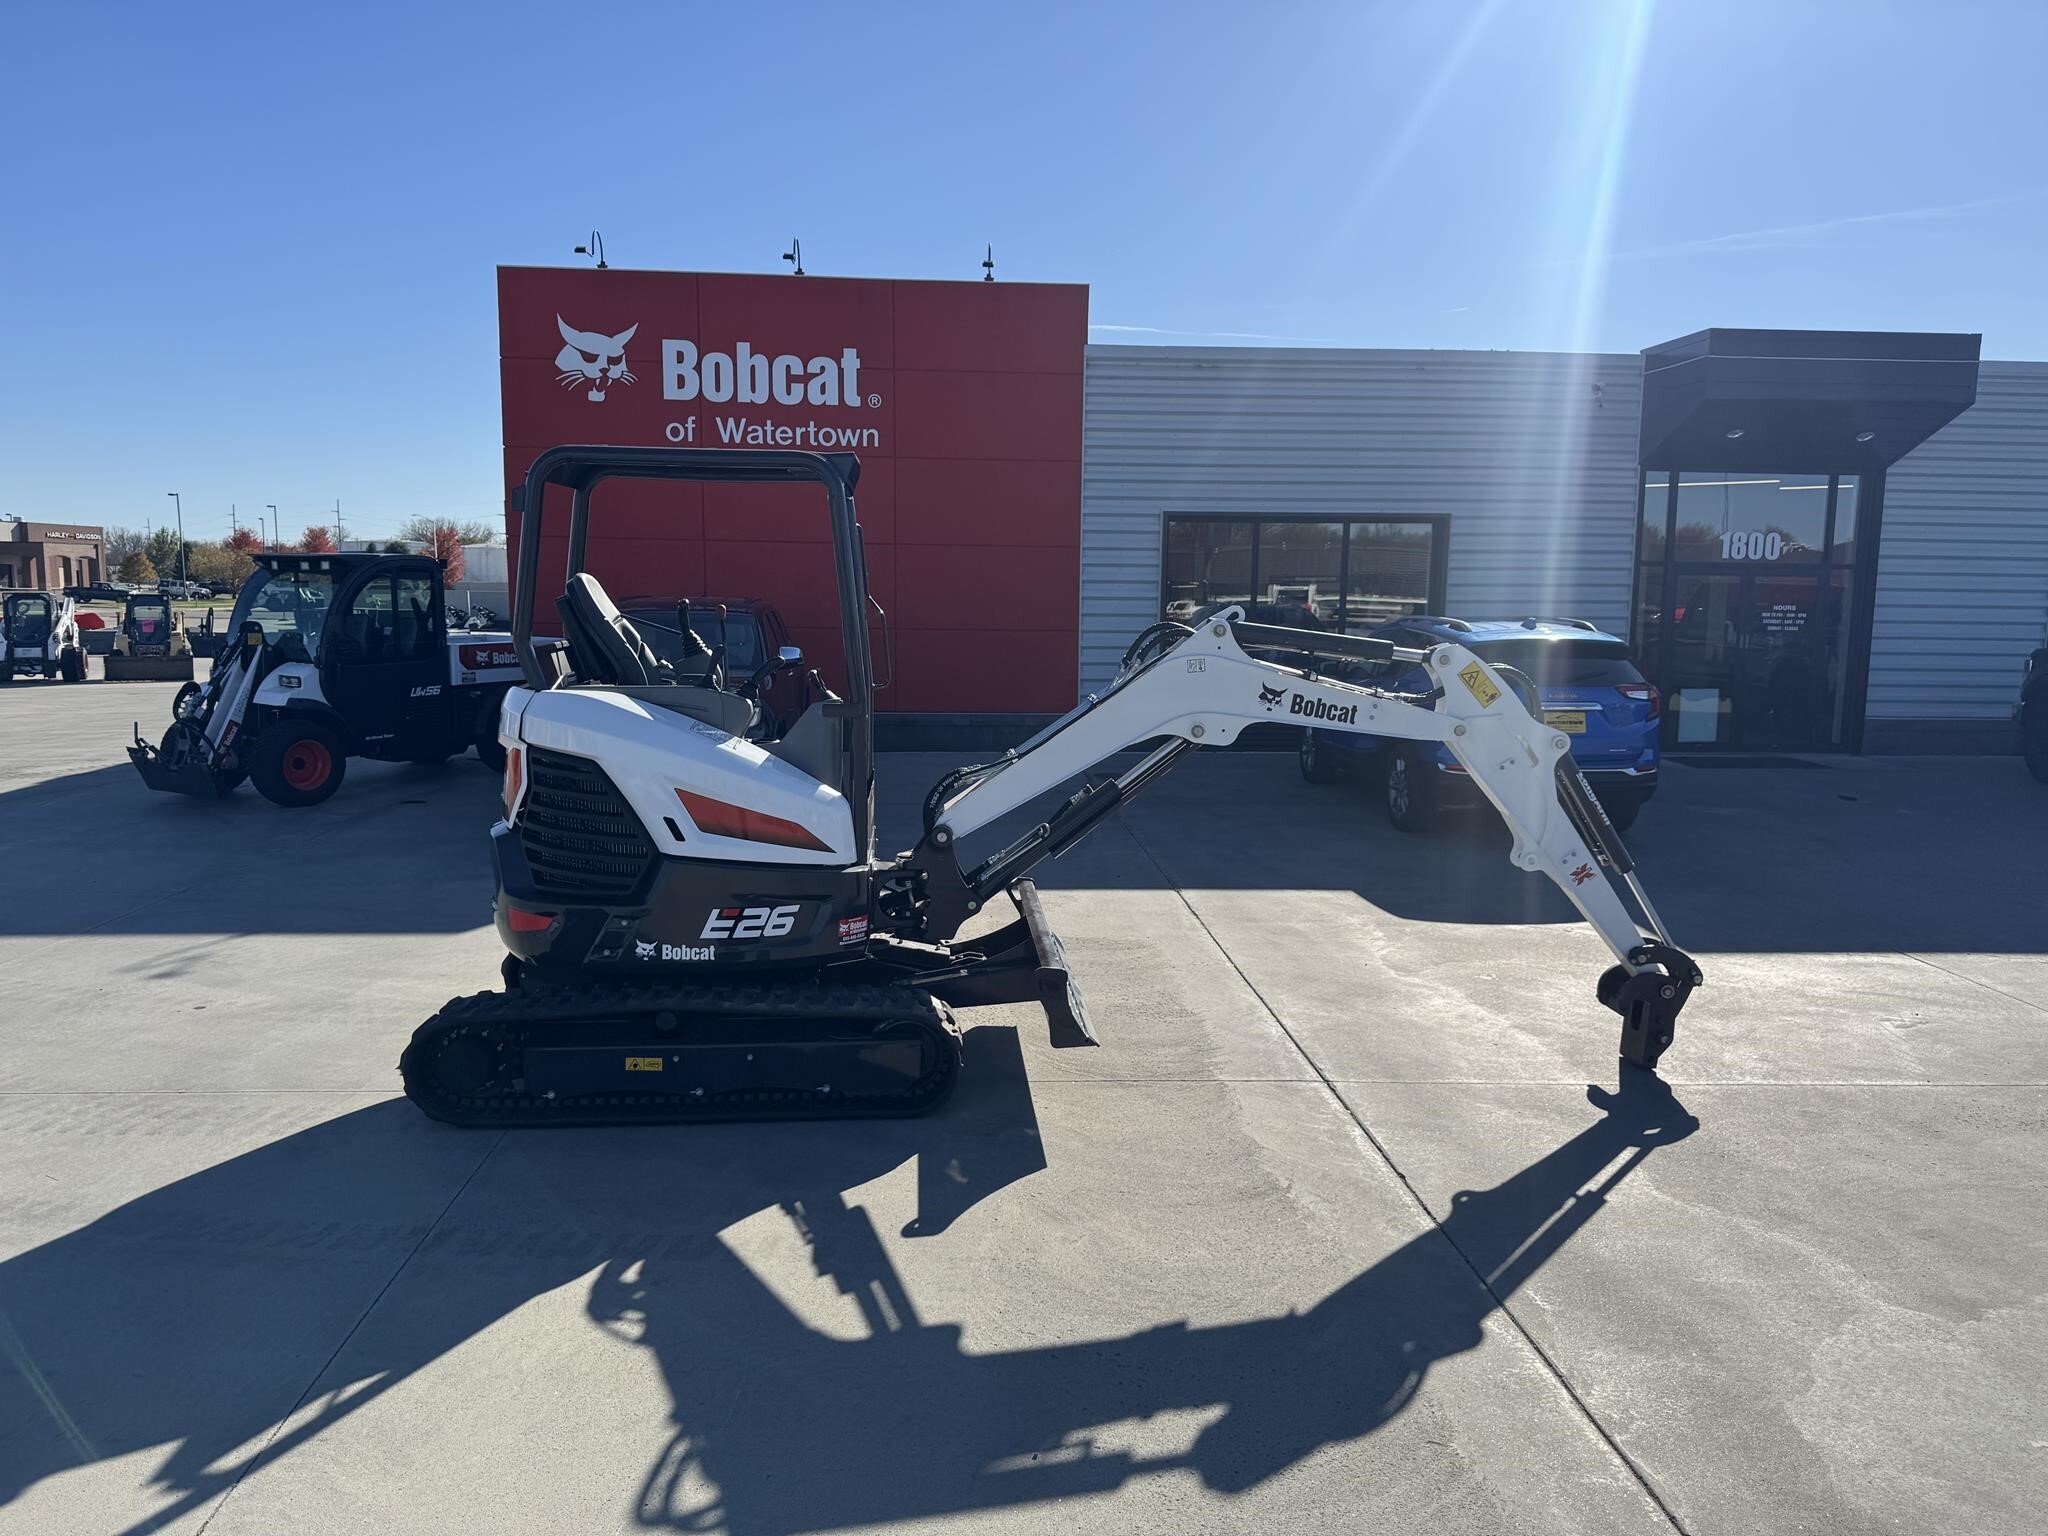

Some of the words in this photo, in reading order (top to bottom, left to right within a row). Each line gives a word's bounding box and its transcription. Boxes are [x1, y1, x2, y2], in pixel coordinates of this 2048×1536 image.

[662, 339, 861, 407] Bobcat
[665, 416, 696, 442] of
[716, 416, 879, 447] Watertown
[1720, 531, 1781, 560] 1800
[1289, 693, 1358, 725] Bobcat
[700, 905, 800, 938] E26
[662, 944, 715, 960] Bobcat
